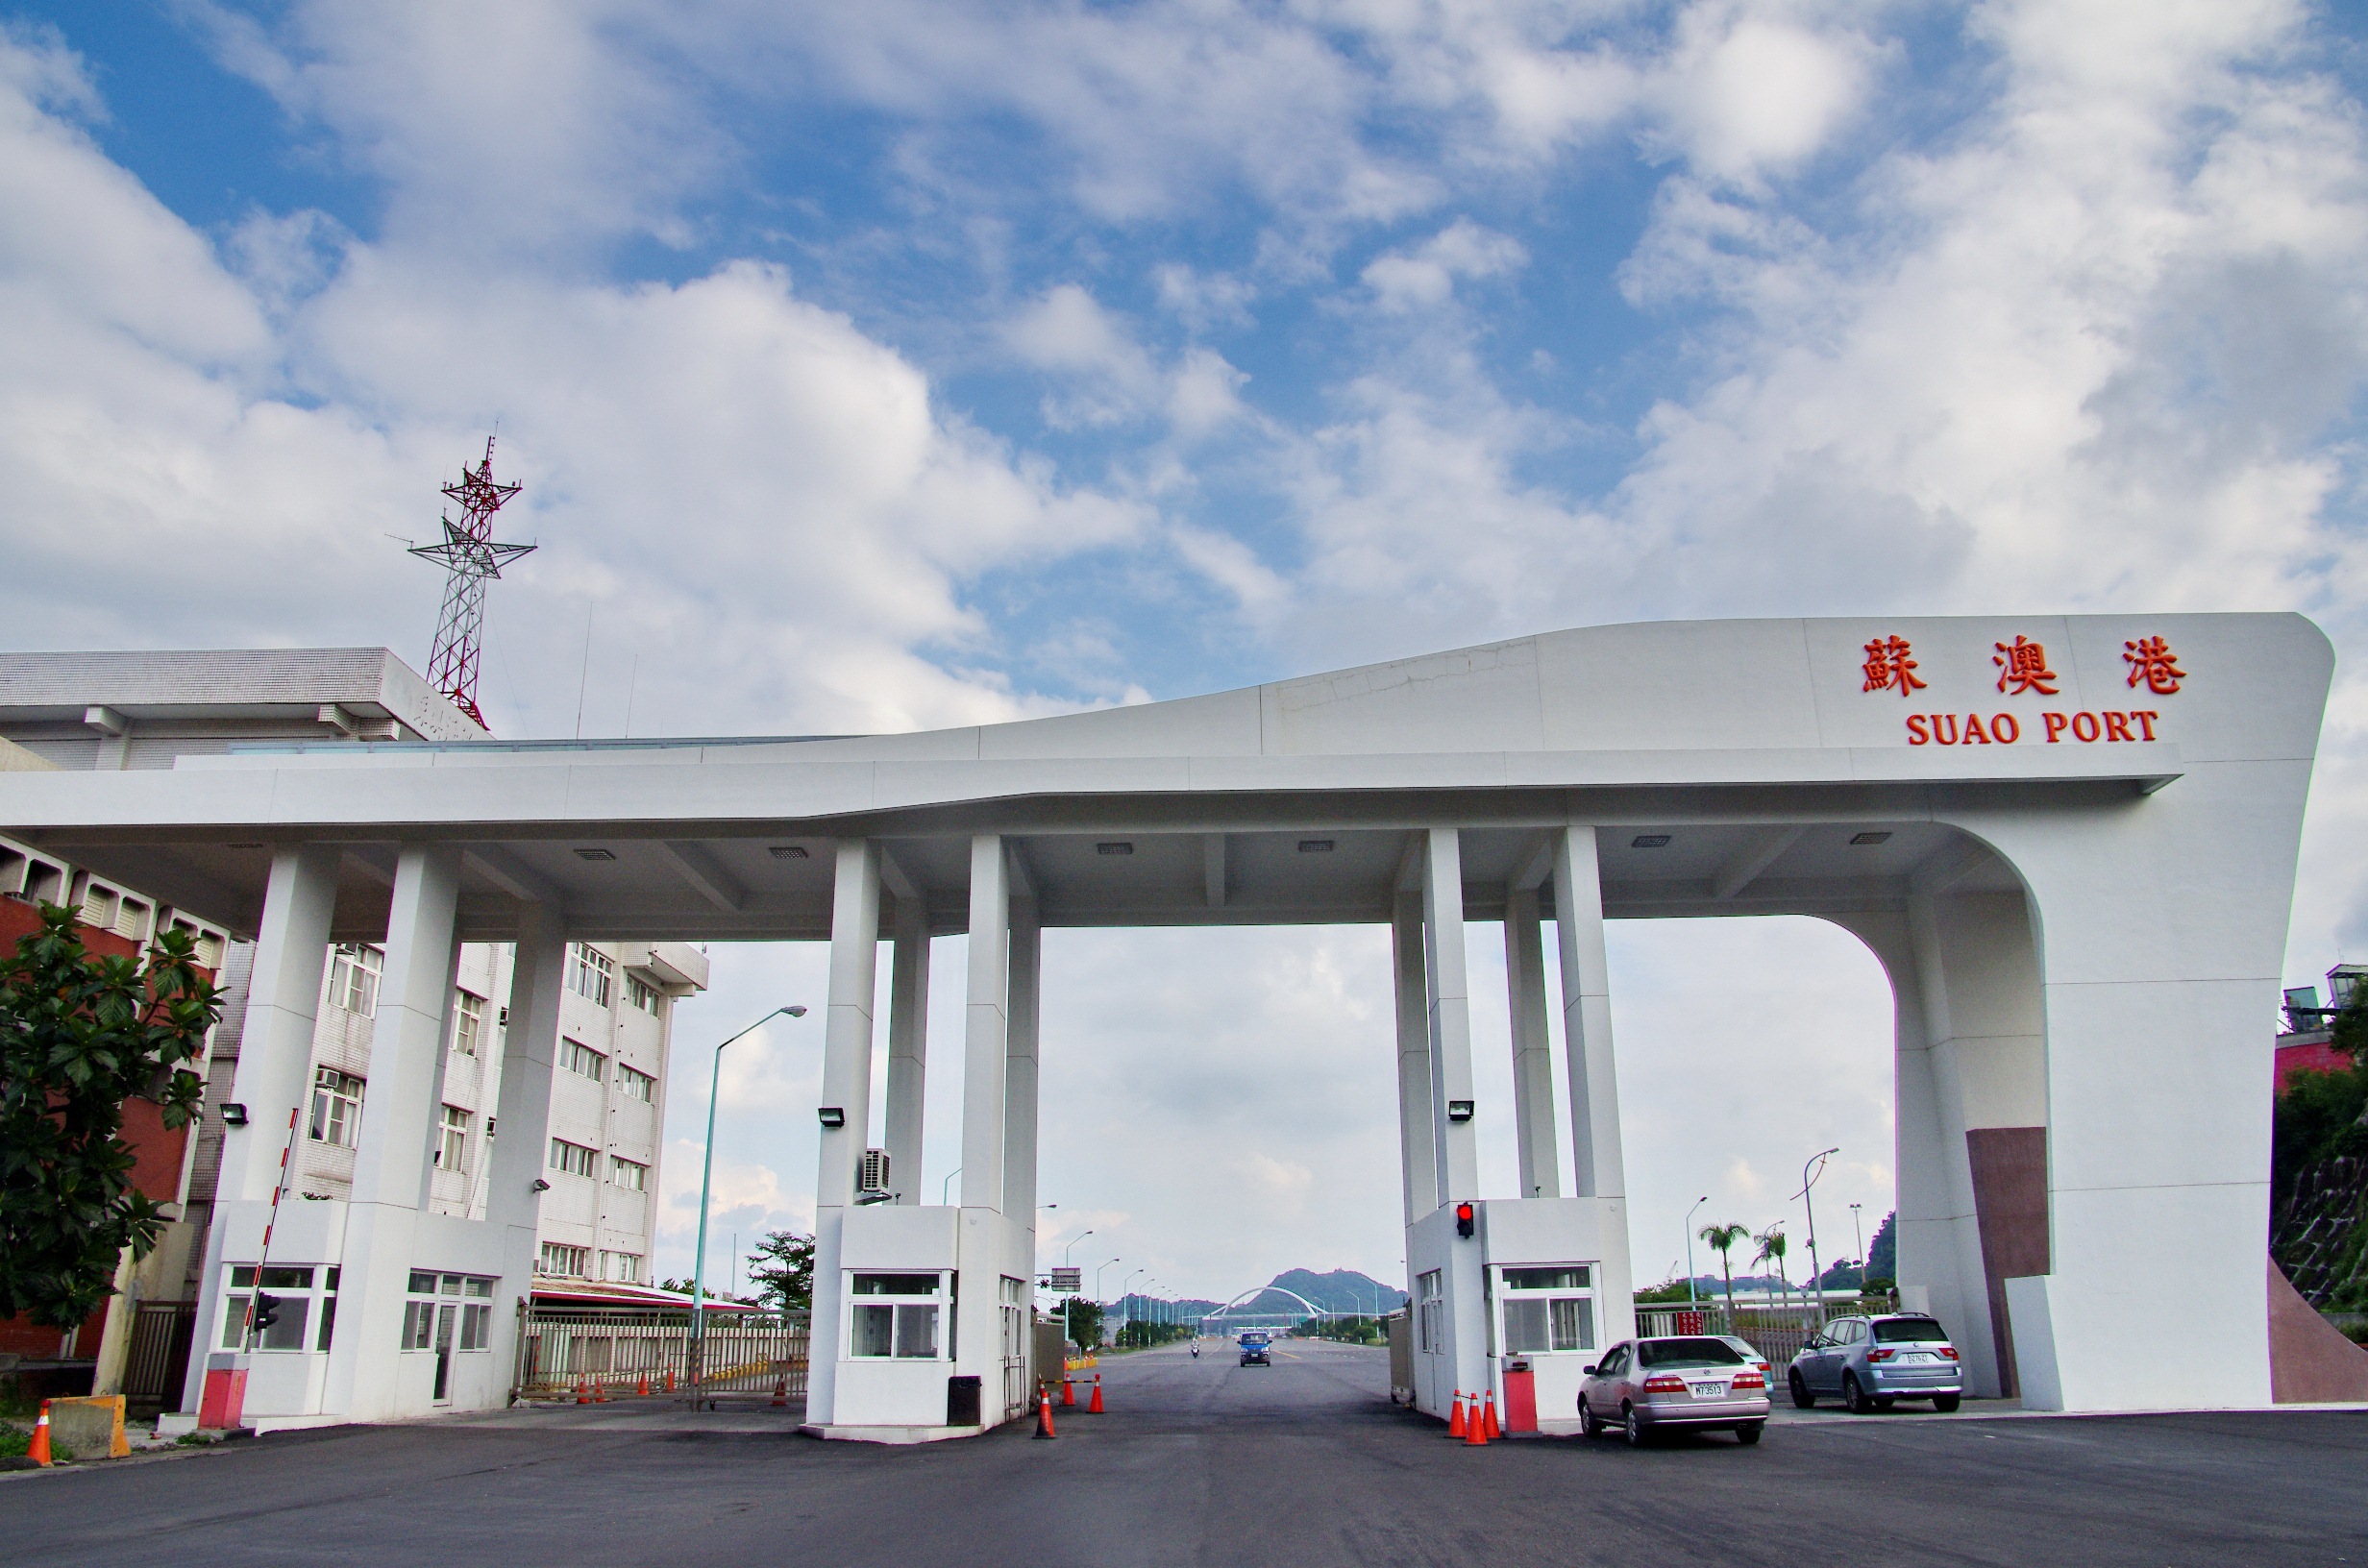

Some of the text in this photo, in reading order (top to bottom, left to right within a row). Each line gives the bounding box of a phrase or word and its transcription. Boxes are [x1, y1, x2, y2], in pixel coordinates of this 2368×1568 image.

[1862, 634, 2186, 697] 蘇澳港
[1906, 710, 2159, 746] SUAO PORT
